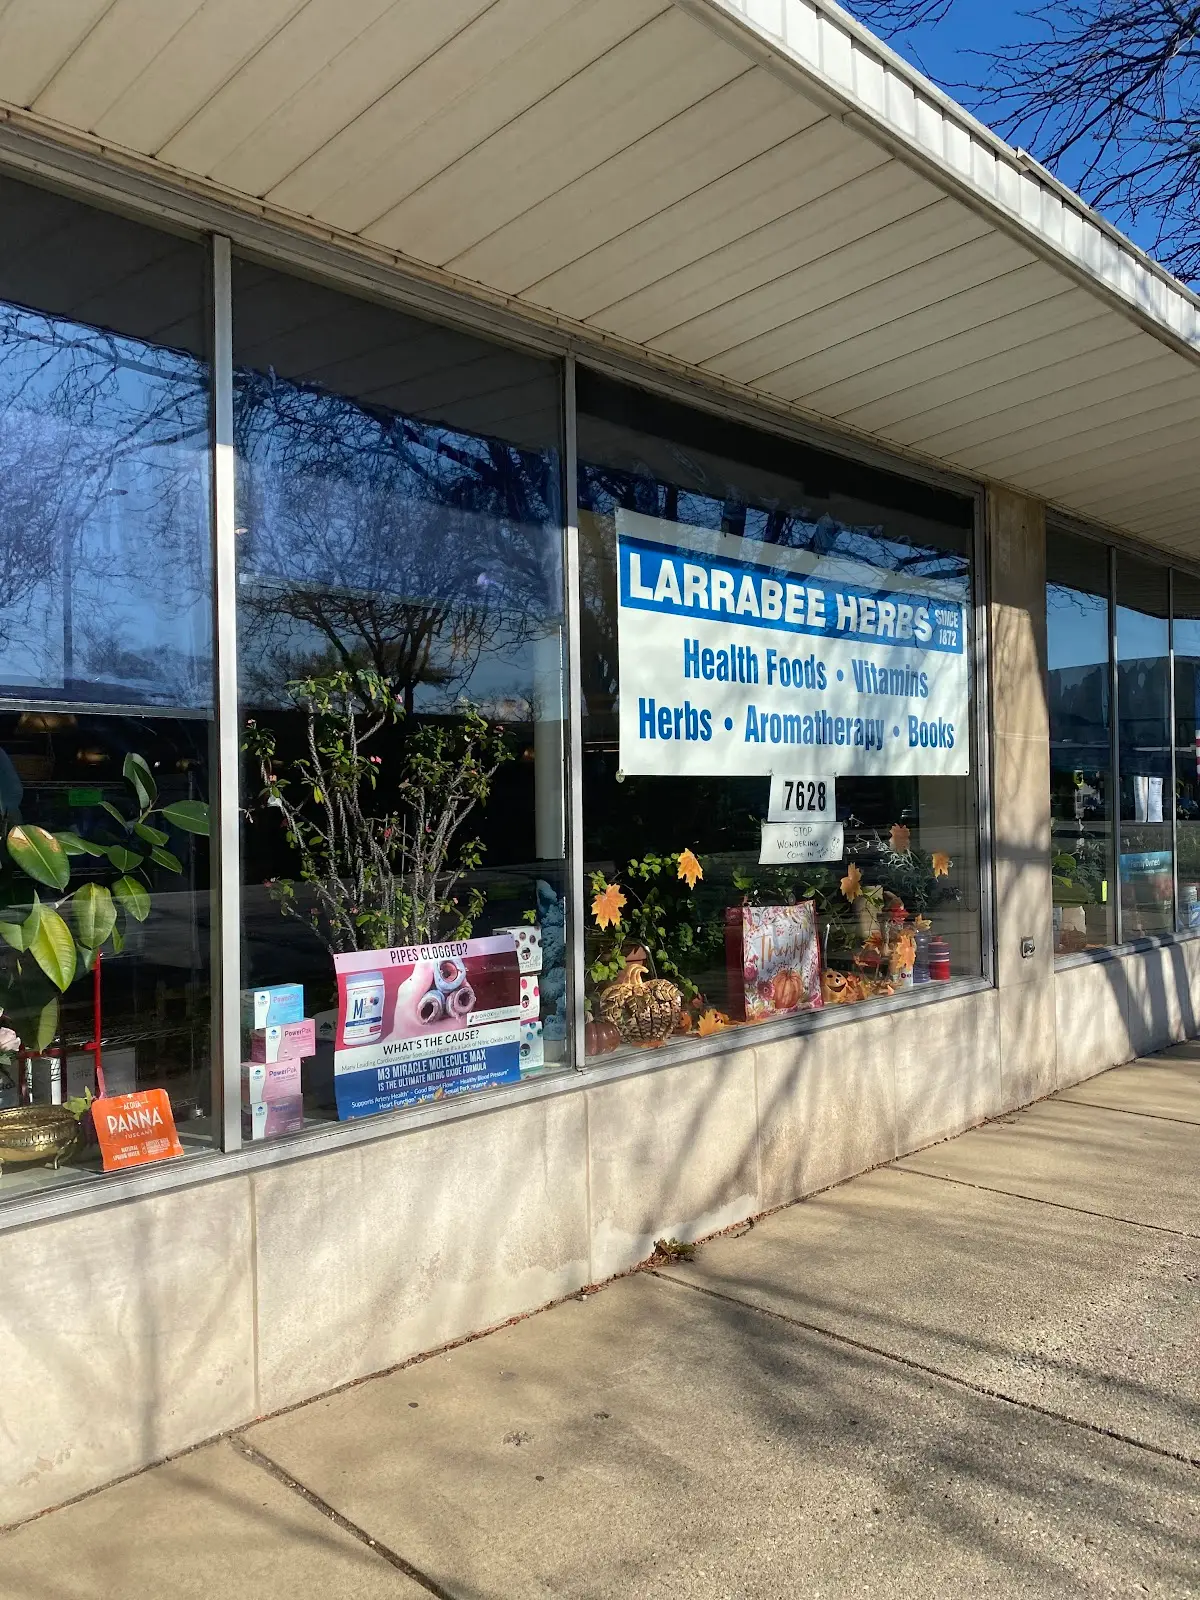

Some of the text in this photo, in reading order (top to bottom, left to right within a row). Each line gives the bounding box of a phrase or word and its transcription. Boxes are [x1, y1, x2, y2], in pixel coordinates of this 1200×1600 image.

[629, 552, 933, 642] LARRABEE HERBS
[934, 609, 959, 629] SINCE
[683, 638, 929, 699] Health Foods Vitamins
[638, 697, 955, 751] Herbs Aromatherapy Books
[784, 781, 826, 812] 7628
[793, 826, 813, 837] STOP
[389, 942, 468, 964] PIPES CLOGGED?
[284, 1027, 312, 1038] PowerPak
[383, 1029, 480, 1056] WHAT'S THE CAUSE?
[268, 1066, 298, 1077] PowerPak
[377, 1048, 487, 1081] M3 MIRACLE MOLECULE MAX
[377, 1062, 487, 1092] IS THE ULTIMATE NITRIC OXIDE FORMULA
[351, 1098, 375, 1109] Supports
[374, 1094, 391, 1104] Artery
[413, 1086, 427, 1095] Good
[428, 1082, 442, 1092] Blood
[459, 1075, 477, 1085] Healthy
[477, 1073, 490, 1081] Blood
[378, 1101, 394, 1111] Heart
[106, 1107, 163, 1135] PANNA
[124, 1129, 153, 1140] TUSCANY
